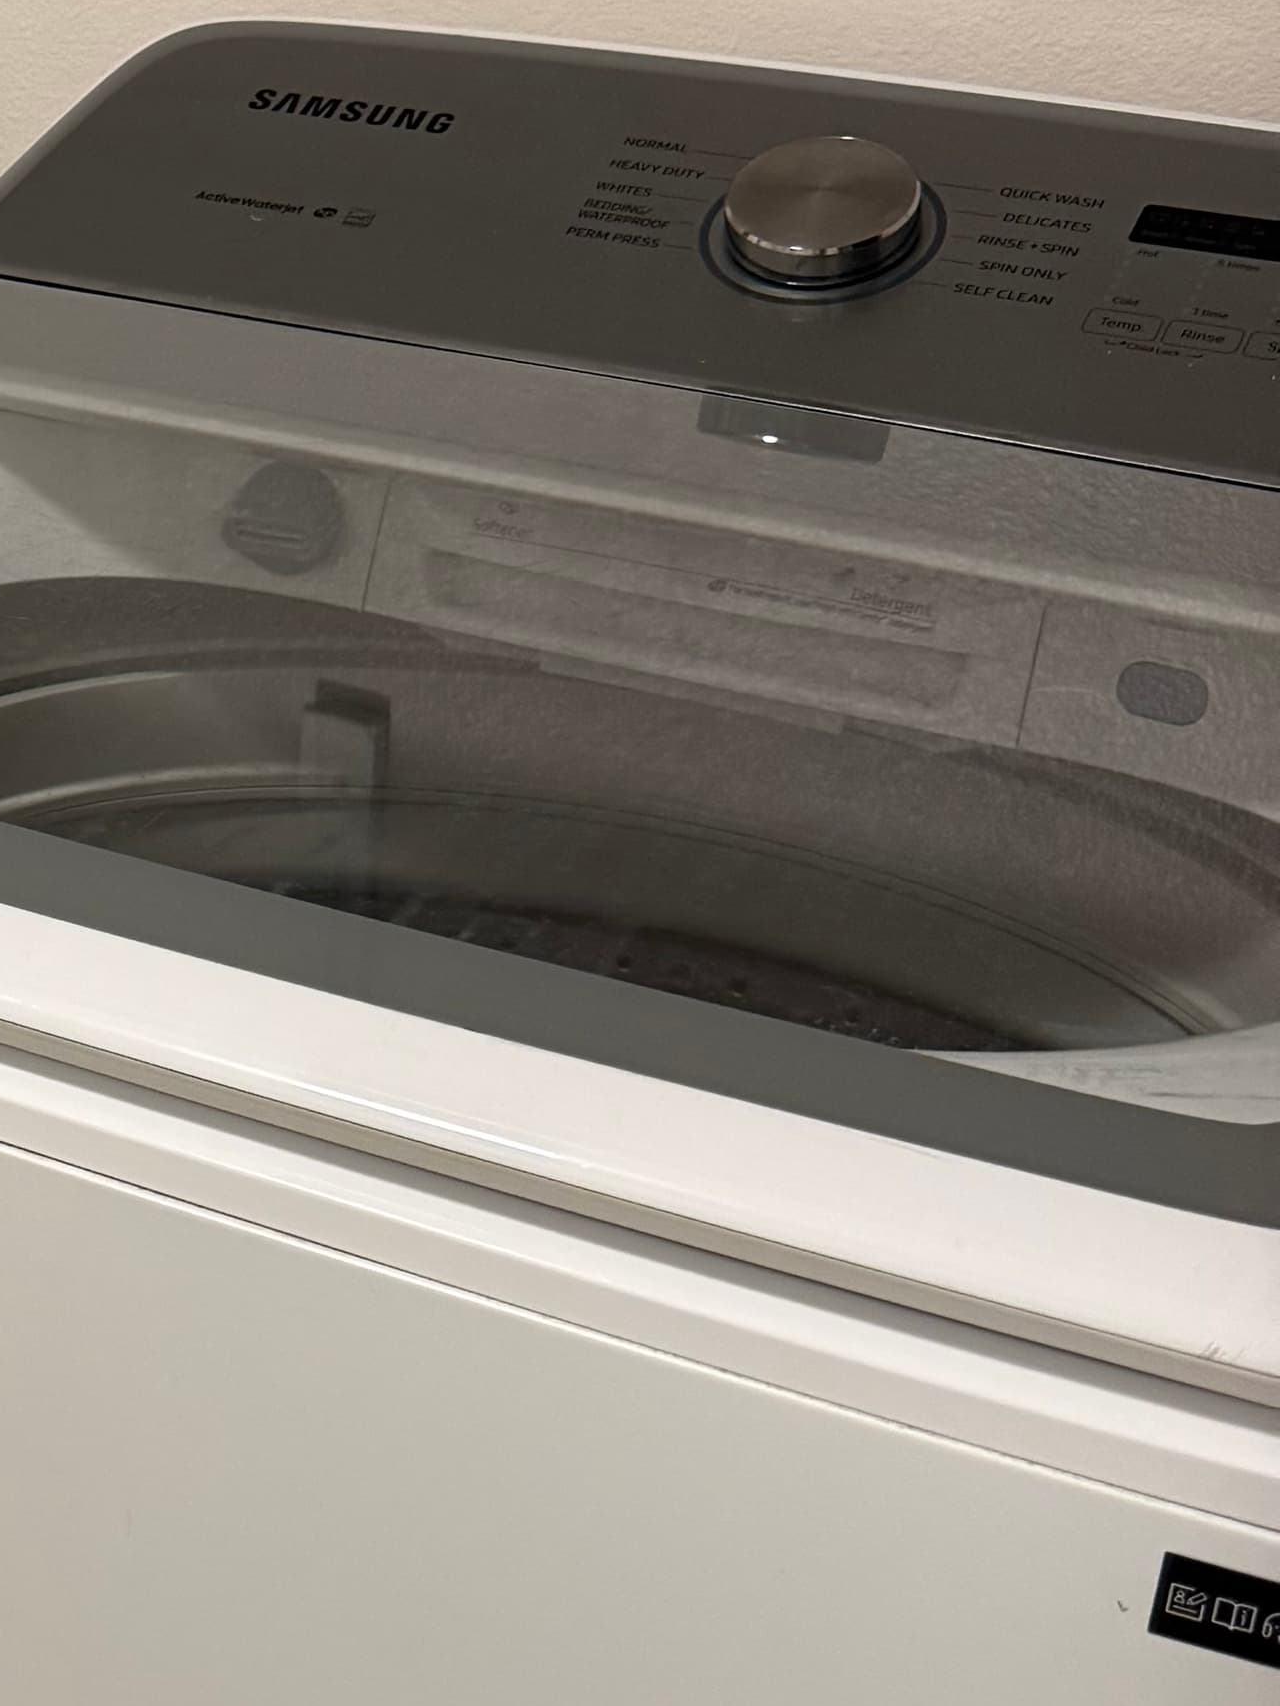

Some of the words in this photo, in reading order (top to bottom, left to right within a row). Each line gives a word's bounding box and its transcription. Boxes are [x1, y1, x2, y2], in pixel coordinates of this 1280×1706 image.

[248, 89, 455, 134] SAMSUNG
[624, 137, 687, 153] NORMAL
[609, 159, 662, 174] HEAVY
[662, 165, 704, 180] DUTY
[596, 182, 652, 197] WHITES
[1000, 187, 1051, 203] QUICK
[1055, 193, 1105, 209] WASH
[578, 210, 670, 229] WATERPROOF
[1002, 213, 1092, 233] DELICATES
[566, 227, 609, 243] PERM
[612, 233, 660, 248] PRESS
[978, 235, 1027, 250] RINSE
[1040, 242, 1079, 257] SPIN
[979, 260, 1017, 275] SPIN
[1021, 266, 1067, 281] ONLY
[954, 283, 993, 298] SELF
[996, 289, 1053, 306] CLEAN
[1180, 329, 1226, 344] Rinse
